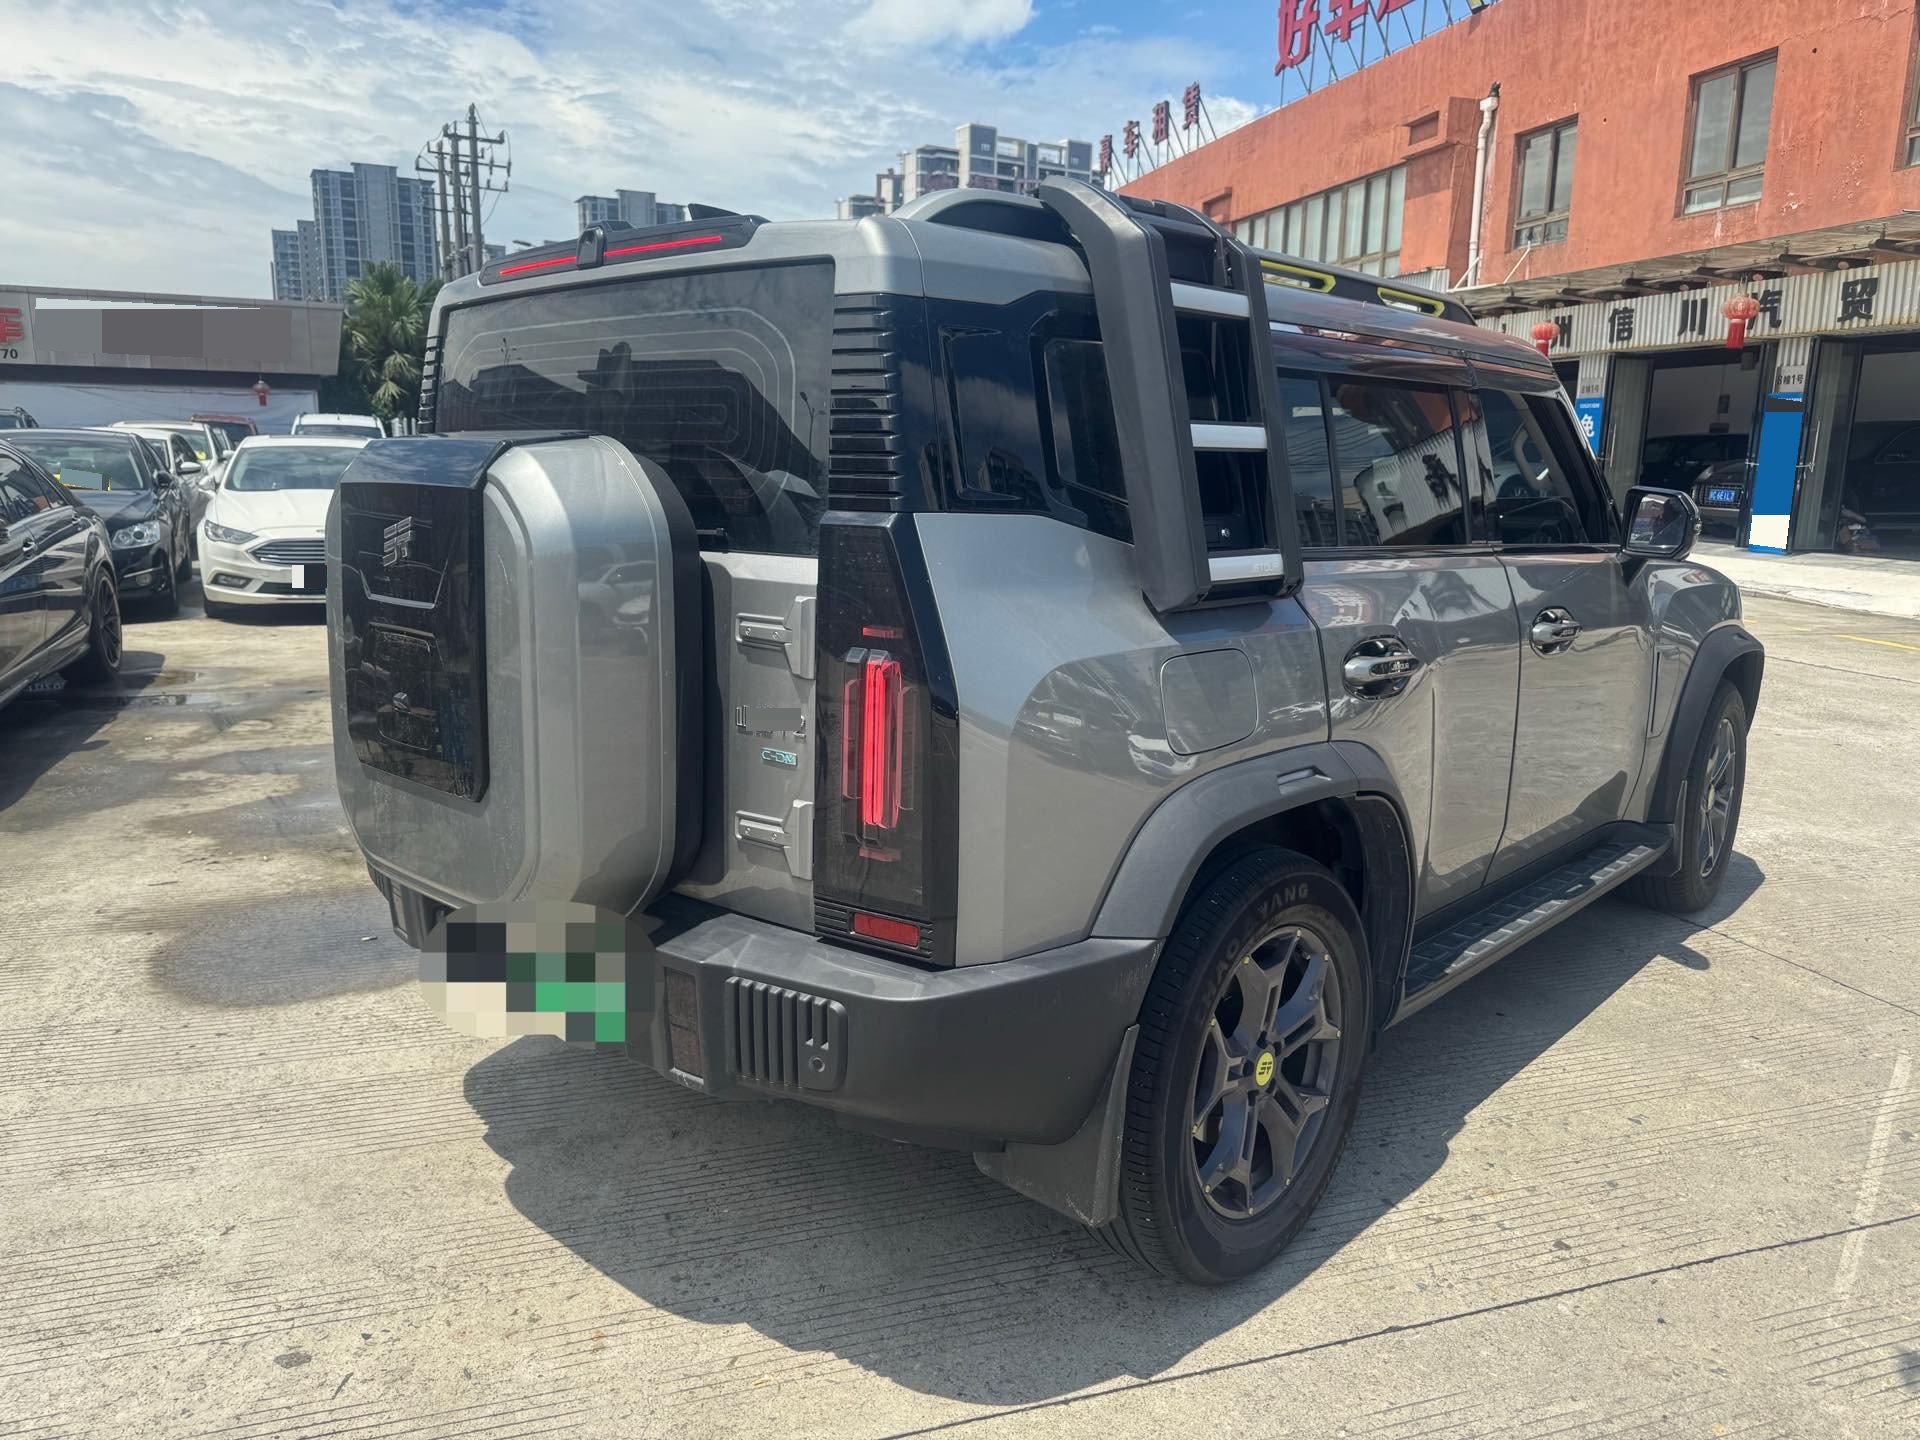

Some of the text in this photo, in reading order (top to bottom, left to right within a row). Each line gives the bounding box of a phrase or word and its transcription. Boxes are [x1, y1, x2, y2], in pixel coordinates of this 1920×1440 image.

[1502, 277, 1880, 349] 州信川汽贸
